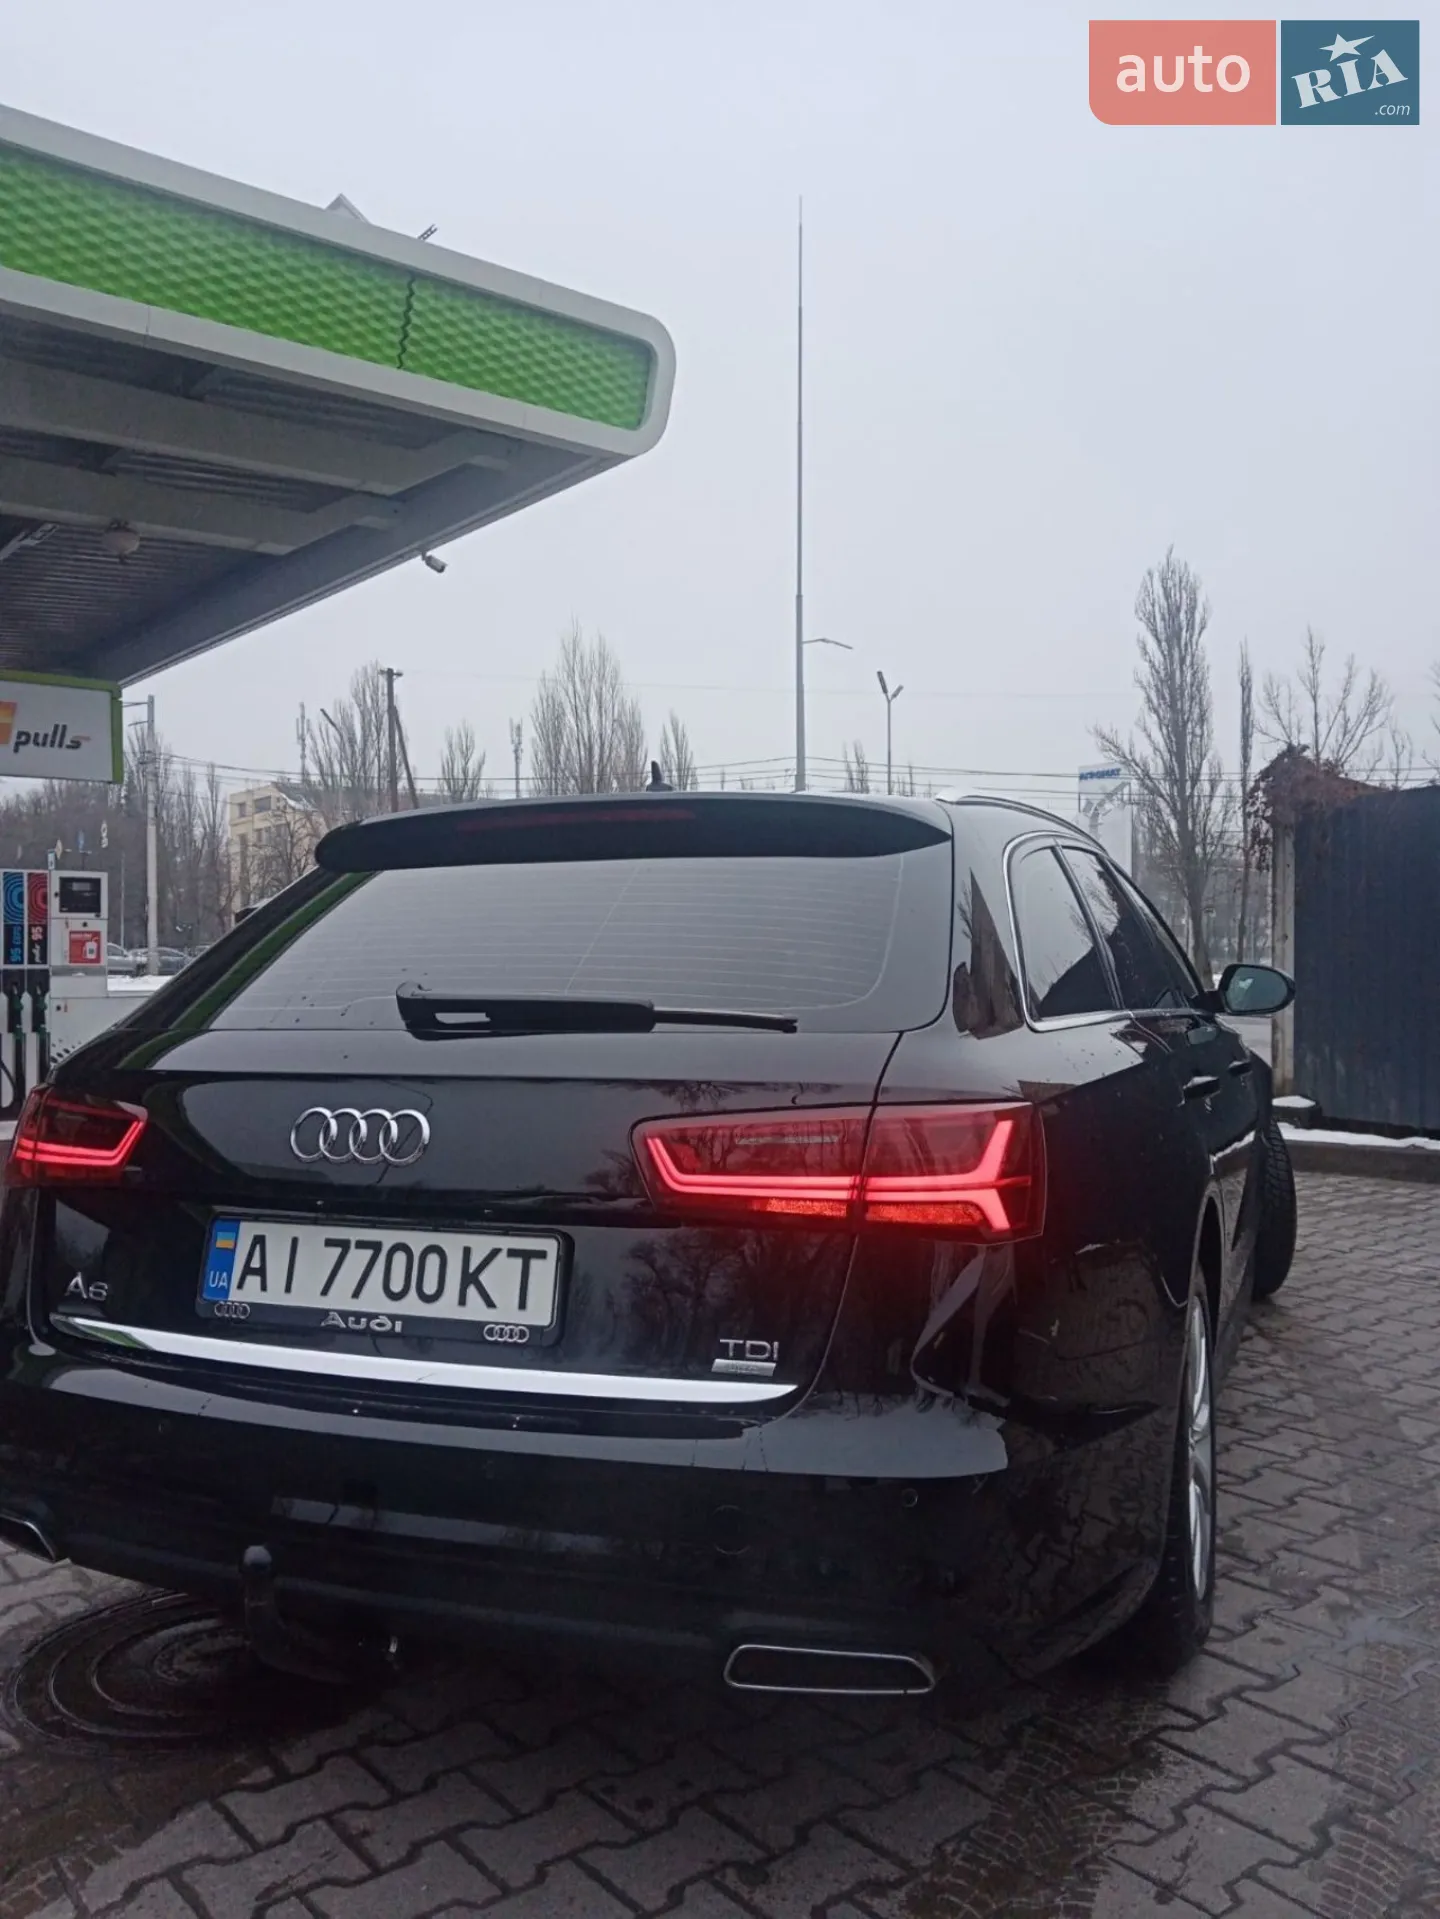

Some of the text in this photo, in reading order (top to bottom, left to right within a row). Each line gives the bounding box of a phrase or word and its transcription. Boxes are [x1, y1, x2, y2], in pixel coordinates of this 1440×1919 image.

[209, 1270, 228, 1289] UA
[319, 1237, 448, 1304] 7700
[457, 1246, 548, 1312] KT
[65, 1271, 109, 1302] A6
[320, 1311, 403, 1333] Audi
[719, 1338, 780, 1361] TDI
